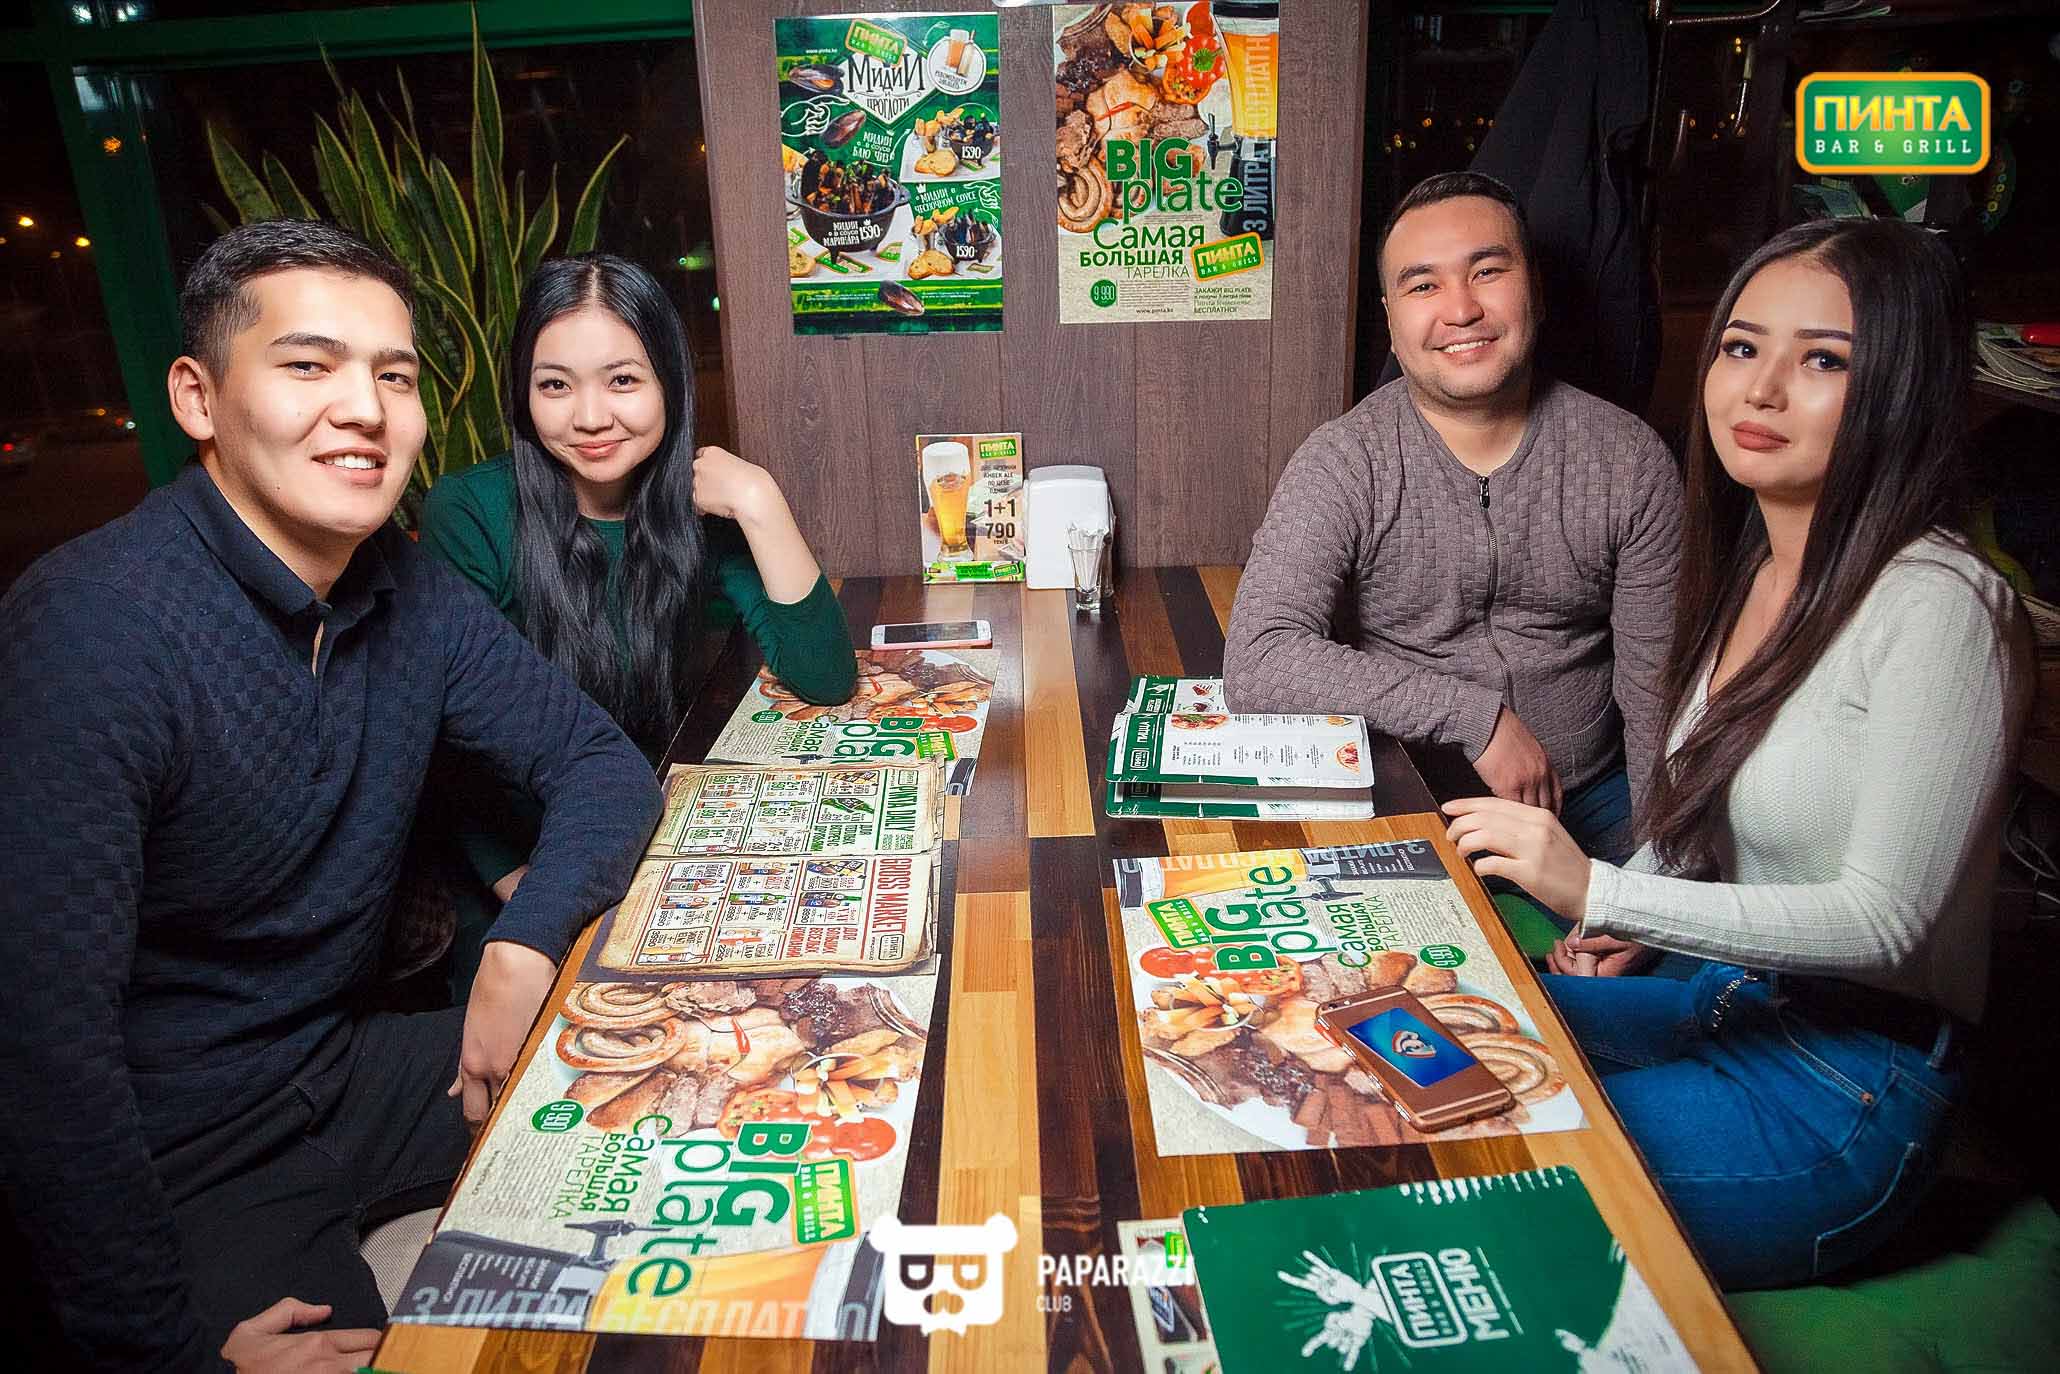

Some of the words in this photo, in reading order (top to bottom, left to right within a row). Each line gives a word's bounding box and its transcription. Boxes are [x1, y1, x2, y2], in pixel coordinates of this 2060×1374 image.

[853, 26, 900, 53] ПИНТА
[866, 97, 910, 120] ПРОГЛОТИ
[962, 146, 981, 159] 1590
[1105, 136, 1193, 182] BIG
[1122, 170, 1245, 224] plate
[859, 224, 881, 241] 1590
[956, 245, 975, 258] 1590
[1092, 217, 1205, 251] Самая
[1079, 250, 1184, 268] БОЛЬШАЯ
[1126, 265, 1190, 280] ТАРЕЛКА
[1197, 242, 1256, 267] ПИНТА
[980, 439, 1015, 451] ПИНТА
[983, 499, 1016, 518] 1+1
[985, 522, 1015, 539] 790
[805, 714, 839, 753] Самая
[869, 716, 926, 758] BIG
[1136, 721, 1152, 743] ПИЦЦА
[884, 809, 917, 832] DAILY
[877, 858, 913, 890] GROSS
[871, 892, 910, 934] MARKET
[1158, 902, 1197, 946] ПИНТА
[1246, 866, 1337, 955] plate
[1352, 902, 1387, 952] БОЛЬШАЯ
[1363, 894, 1402, 950] ТАРЕЛКА
[1204, 902, 1280, 972] BIG
[1324, 903, 1371, 970] Самая
[547, 1132, 606, 1221] ТАРЕЛКА
[578, 1132, 626, 1211] БОЛЬШАЯ
[598, 1114, 673, 1213] Самая
[711, 1120, 811, 1227] BIG
[625, 1139, 735, 1298] plate
[813, 1160, 846, 1240] ПИНТА
[1389, 1262, 1440, 1338] ПИНТА
[1437, 1247, 1511, 1341] МЕНЮ
